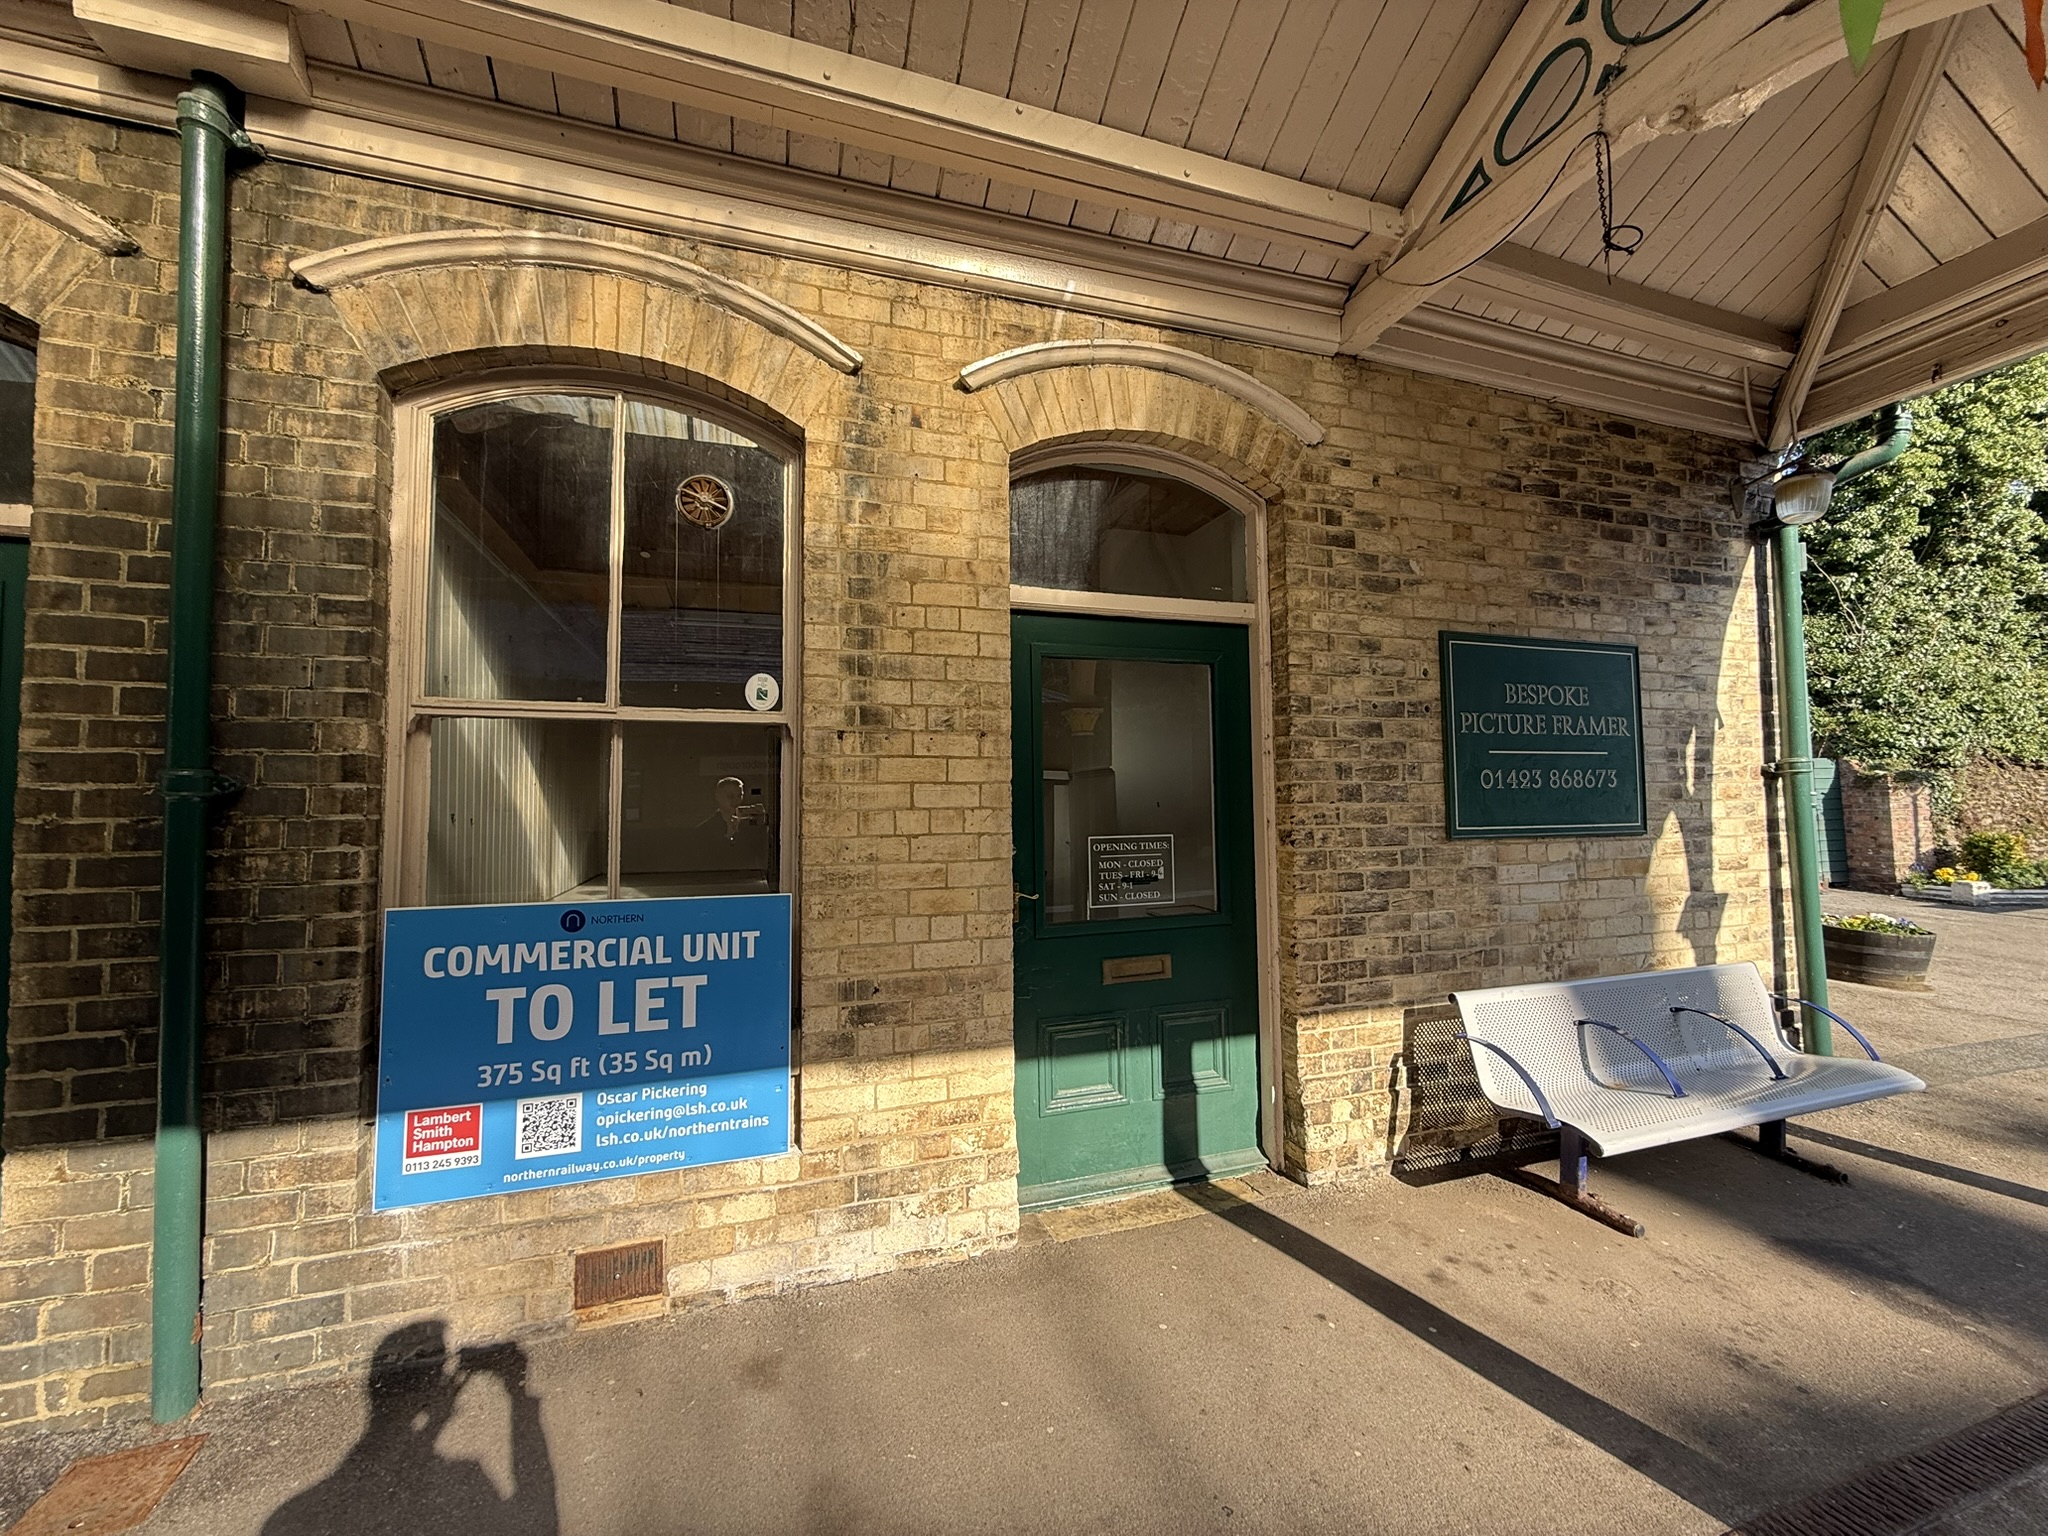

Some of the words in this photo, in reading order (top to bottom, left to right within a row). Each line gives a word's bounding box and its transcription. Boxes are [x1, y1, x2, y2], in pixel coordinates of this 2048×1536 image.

[1505, 683, 1590, 706] BESPOKE
[1460, 712, 1547, 735] PICTURE
[1552, 715, 1631, 737] FRAMER
[1480, 769, 1542, 789] 01423
[1550, 769, 1617, 789] 868673
[1093, 843, 1137, 852] OPENING
[1139, 841, 1170, 850] TIMES:
[1098, 861, 1121, 869] MON
[1128, 859, 1164, 868] CLOSED
[1099, 872, 1122, 880] TUES
[1130, 870, 1144, 878] FRI
[1098, 883, 1115, 891] SAT
[1098, 894, 1118, 902] SUN
[1125, 891, 1160, 900] CLOSED
[591, 914, 644, 925] NORTHERN
[424, 936, 672, 978] COMMERCIAL
[683, 930, 760, 963] UNIT
[485, 984, 574, 1044] TO
[598, 975, 708, 1035] LET
[477, 1064, 522, 1088] 375
[531, 1060, 561, 1084] Sq
[570, 1057, 590, 1078] ft
[598, 1052, 637, 1076] (35
[645, 1049, 673, 1075] Sq
[681, 1044, 712, 1066] m)
[596, 1092, 638, 1106] Oscar
[642, 1083, 707, 1101] Pickering
[414, 1110, 471, 1127] Lambert
[596, 1097, 748, 1129] opickering@lsh.co.uk
[413, 1127, 452, 1141] Smith
[596, 1114, 770, 1147] lsh.co.uk/northerntrains
[412, 1137, 474, 1153] Hampton
[405, 1163, 430, 1172] 0113
[432, 1160, 452, 1169] 245
[454, 1155, 479, 1166] 9393
[503, 1150, 686, 1183] northernrailway.co.uk/property
